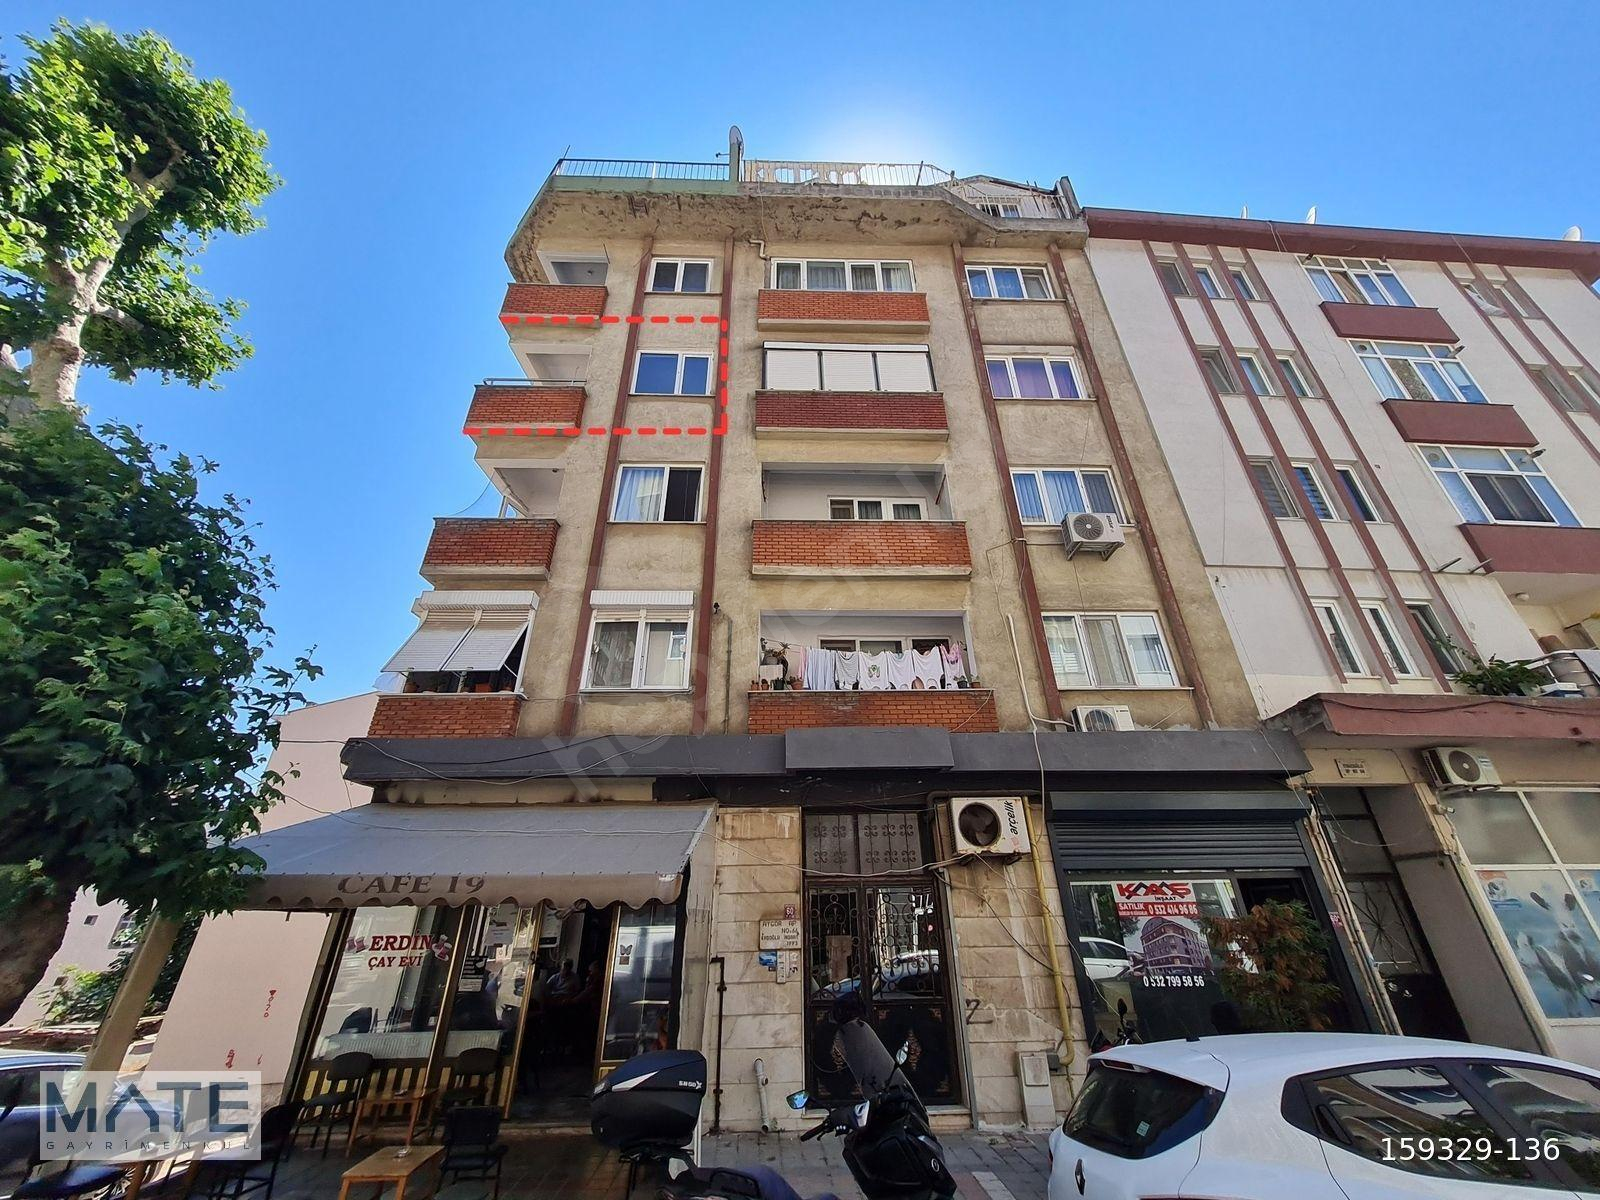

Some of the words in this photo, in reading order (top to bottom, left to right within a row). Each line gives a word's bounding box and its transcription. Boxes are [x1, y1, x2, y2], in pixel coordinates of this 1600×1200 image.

[1004, 801, 1019, 835] arçelik
[338, 875, 433, 894] CAFE
[448, 875, 485, 895] 19
[1119, 903, 1145, 911] SATILIK
[1148, 905, 1153, 915] 0
[1155, 905, 1167, 915] 532
[368, 929, 433, 951] ERDİN
[368, 956, 396, 970] ÇAY
[398, 952, 423, 967] EVİ
[1143, 975, 1149, 987] 0
[1150, 975, 1166, 987] 532
[1166, 975, 1182, 987] 799
[1182, 975, 1194, 987] 58
[1194, 975, 1205, 987] 56
